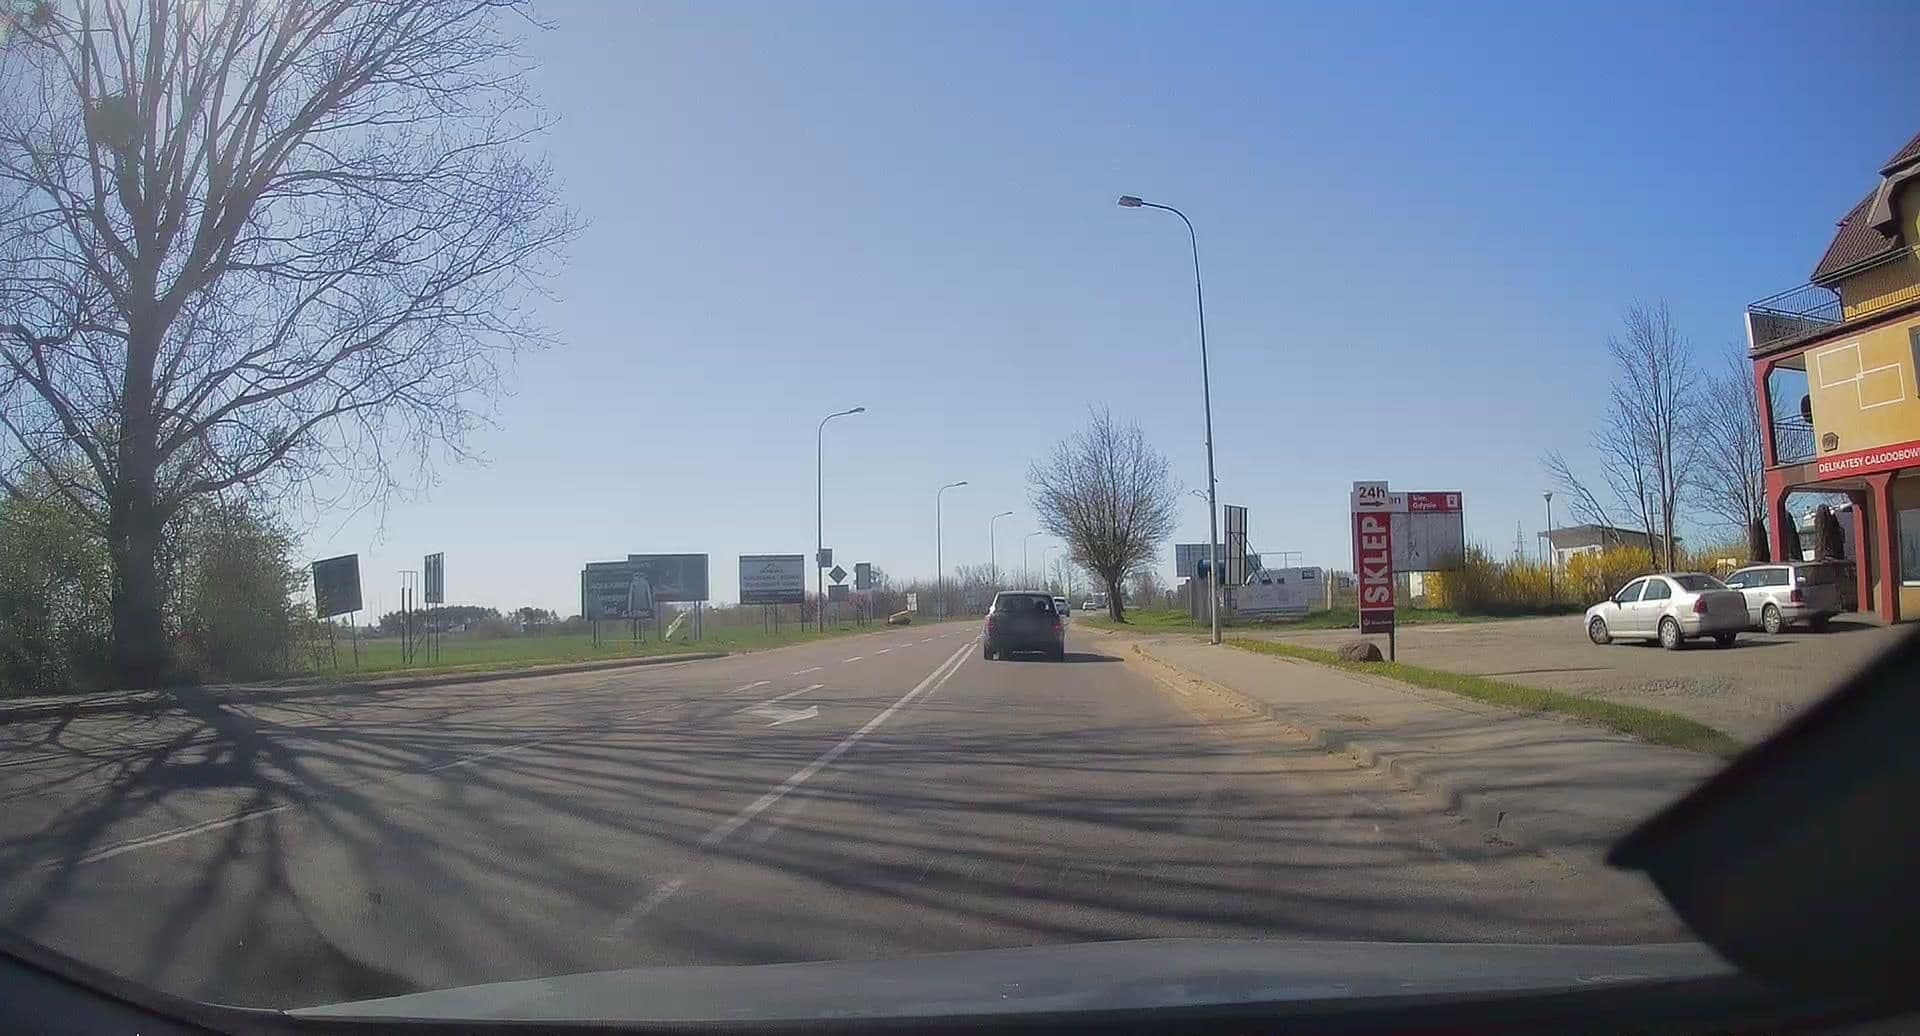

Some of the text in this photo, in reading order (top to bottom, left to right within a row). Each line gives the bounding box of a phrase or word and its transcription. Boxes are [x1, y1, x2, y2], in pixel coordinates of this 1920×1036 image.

[1818, 457, 1863, 473] DELIKATESY
[1360, 486, 1385, 498] 24h
[1361, 516, 1389, 603] SKLEP
